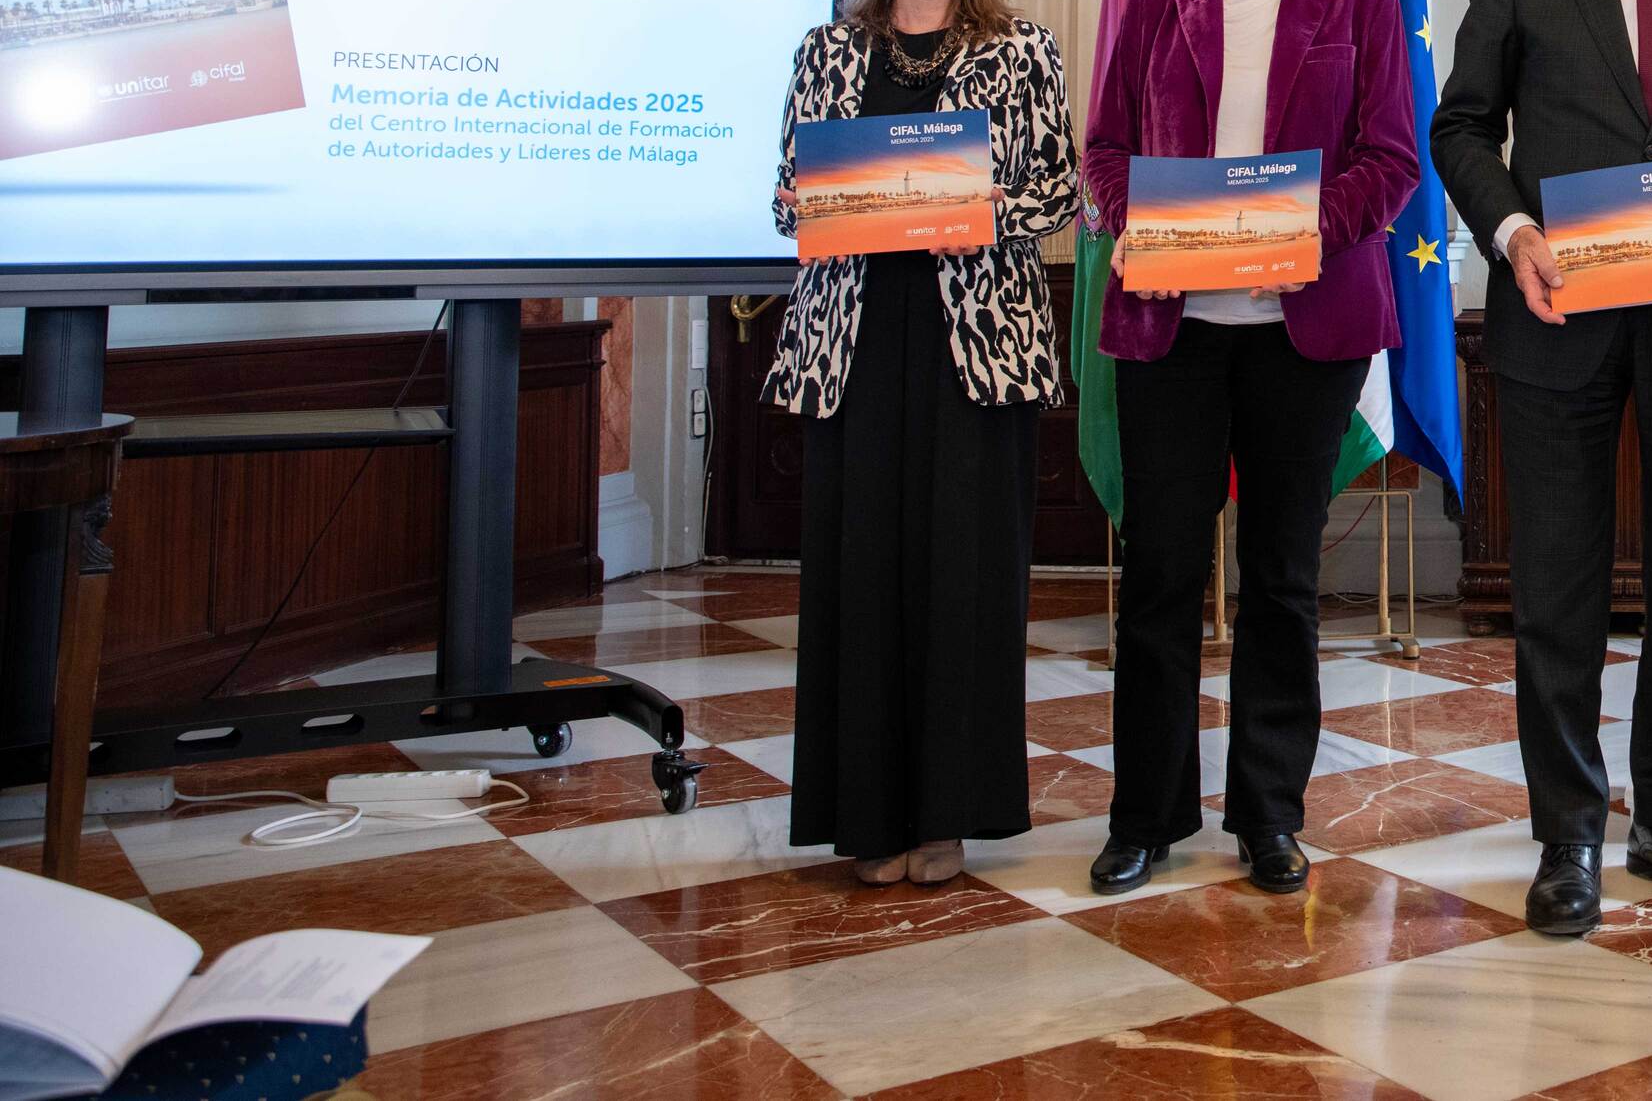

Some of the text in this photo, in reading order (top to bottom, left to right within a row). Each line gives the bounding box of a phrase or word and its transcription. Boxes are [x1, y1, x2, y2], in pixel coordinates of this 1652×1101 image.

[209, 60, 246, 79] cifal
[333, 51, 499, 73] PRESENTACIÓN
[115, 74, 169, 96] unitar
[331, 83, 705, 113] Memoria de Actividades 2025
[329, 114, 734, 139] del Centro Internacional de Formación
[890, 122, 963, 136] CIFAL Málaga
[890, 137, 920, 145] MEMORIA
[328, 140, 698, 166] de Autoridades y Líderes de Málaga
[1227, 163, 1297, 178] CIFAL Málaga
[1227, 176, 1269, 186] MEMORIA 2025
